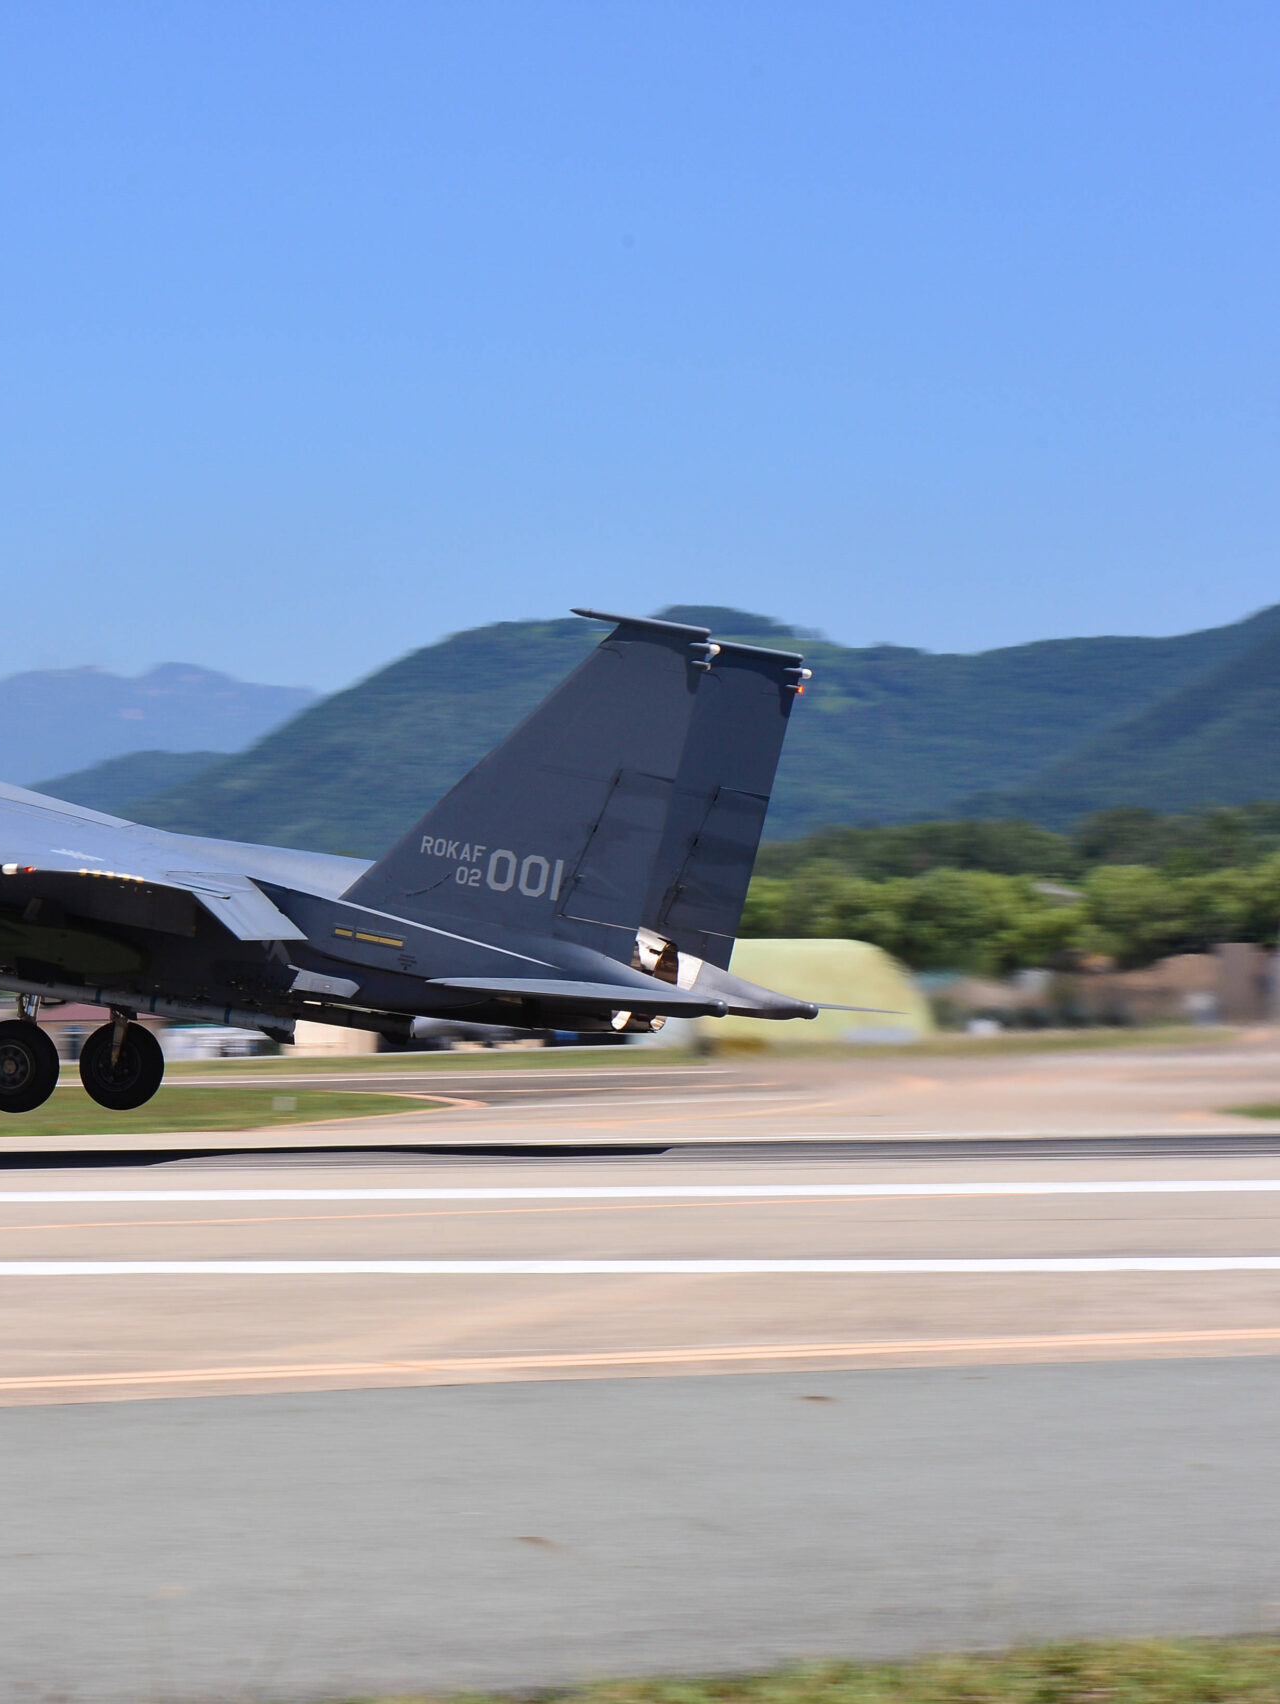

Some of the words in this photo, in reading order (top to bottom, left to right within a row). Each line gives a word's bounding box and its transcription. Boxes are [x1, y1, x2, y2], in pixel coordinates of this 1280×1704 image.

[420, 835, 487, 863] ROKAF
[455, 866, 482, 887] 02
[486, 848, 565, 901] 001
